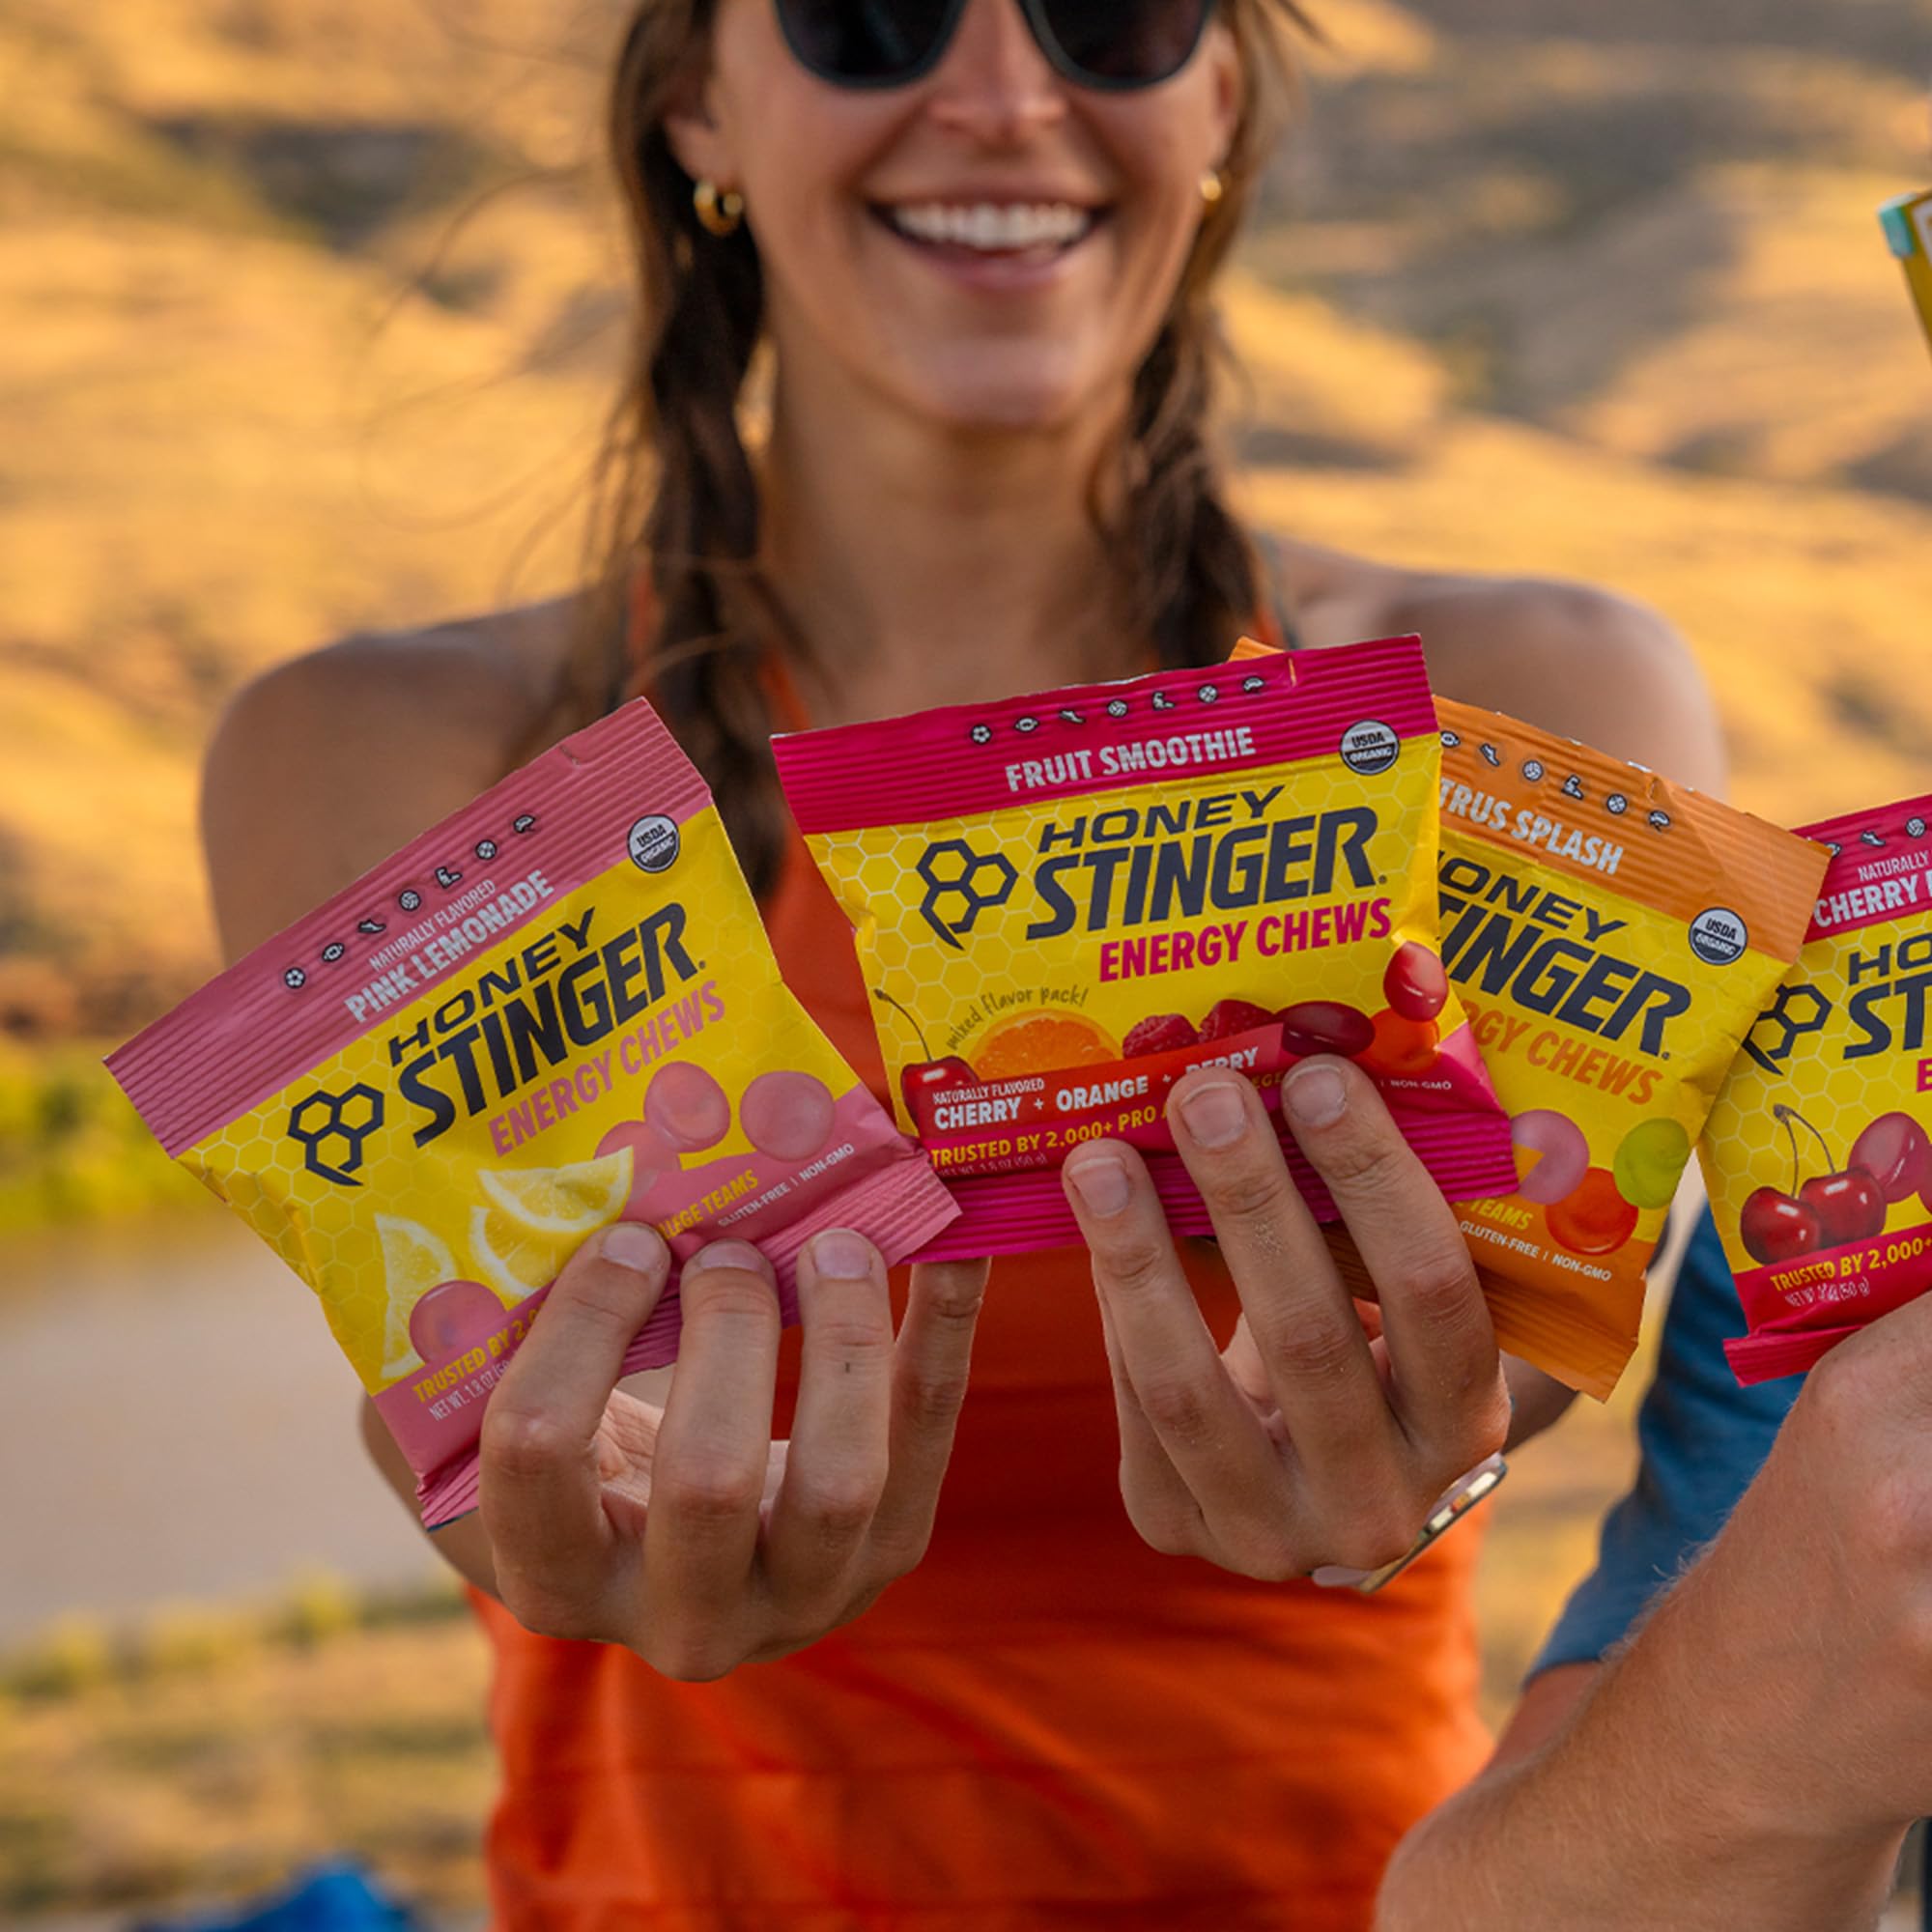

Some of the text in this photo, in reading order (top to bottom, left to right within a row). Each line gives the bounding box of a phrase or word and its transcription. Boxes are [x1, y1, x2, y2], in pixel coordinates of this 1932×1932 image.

[1005, 726, 1257, 792] FRUIT SMOOTHIE
[1351, 731, 1385, 749] USDA
[637, 824, 667, 847] USDA
[1037, 785, 1286, 853] HONEY
[1439, 778, 1624, 874] TRUS SPLASH
[1438, 849, 1629, 943] ONEY
[1858, 850, 1930, 882] NATURALLY
[368, 879, 497, 971] NATURALLY FLAVORED
[1705, 918, 1737, 940] USDA
[1814, 872, 1919, 928] CHERRY
[344, 869, 554, 1023] PINK LEMONADE
[1099, 898, 1393, 982] ENERGY CHEWS
[1848, 932, 1932, 986] HO
[388, 906, 595, 1067] HONEY
[1439, 891, 1691, 1059] TINGER
[946, 984, 1089, 1051] mixed flavor pack!
[1843, 970, 1932, 1060] ST
[488, 980, 725, 1157] ENERGY CHEWS
[933, 1077, 1045, 1105] NATURALLY FLAVORED
[1527, 1029, 1664, 1105] CHEWS
[934, 1097, 1021, 1129] CHERRY
[1056, 1075, 1149, 1111] ORANGE
[931, 1139, 1011, 1168] TRUSTED
[1016, 1133, 1040, 1152] BY
[1118, 1105, 1157, 1133] PRO
[700, 1169, 758, 1214] TEAMS
[718, 1143, 855, 1228] GLUTEN-FREE NON-GMO
[1469, 1199, 1534, 1231] TEAMS
[1460, 1220, 1612, 1282] GLUTEN-FREE NON-GMO
[1770, 1261, 1835, 1292] TRUSTED
[1840, 1252, 1863, 1277] BY
[412, 1328, 510, 1403] TRUSTED BY
